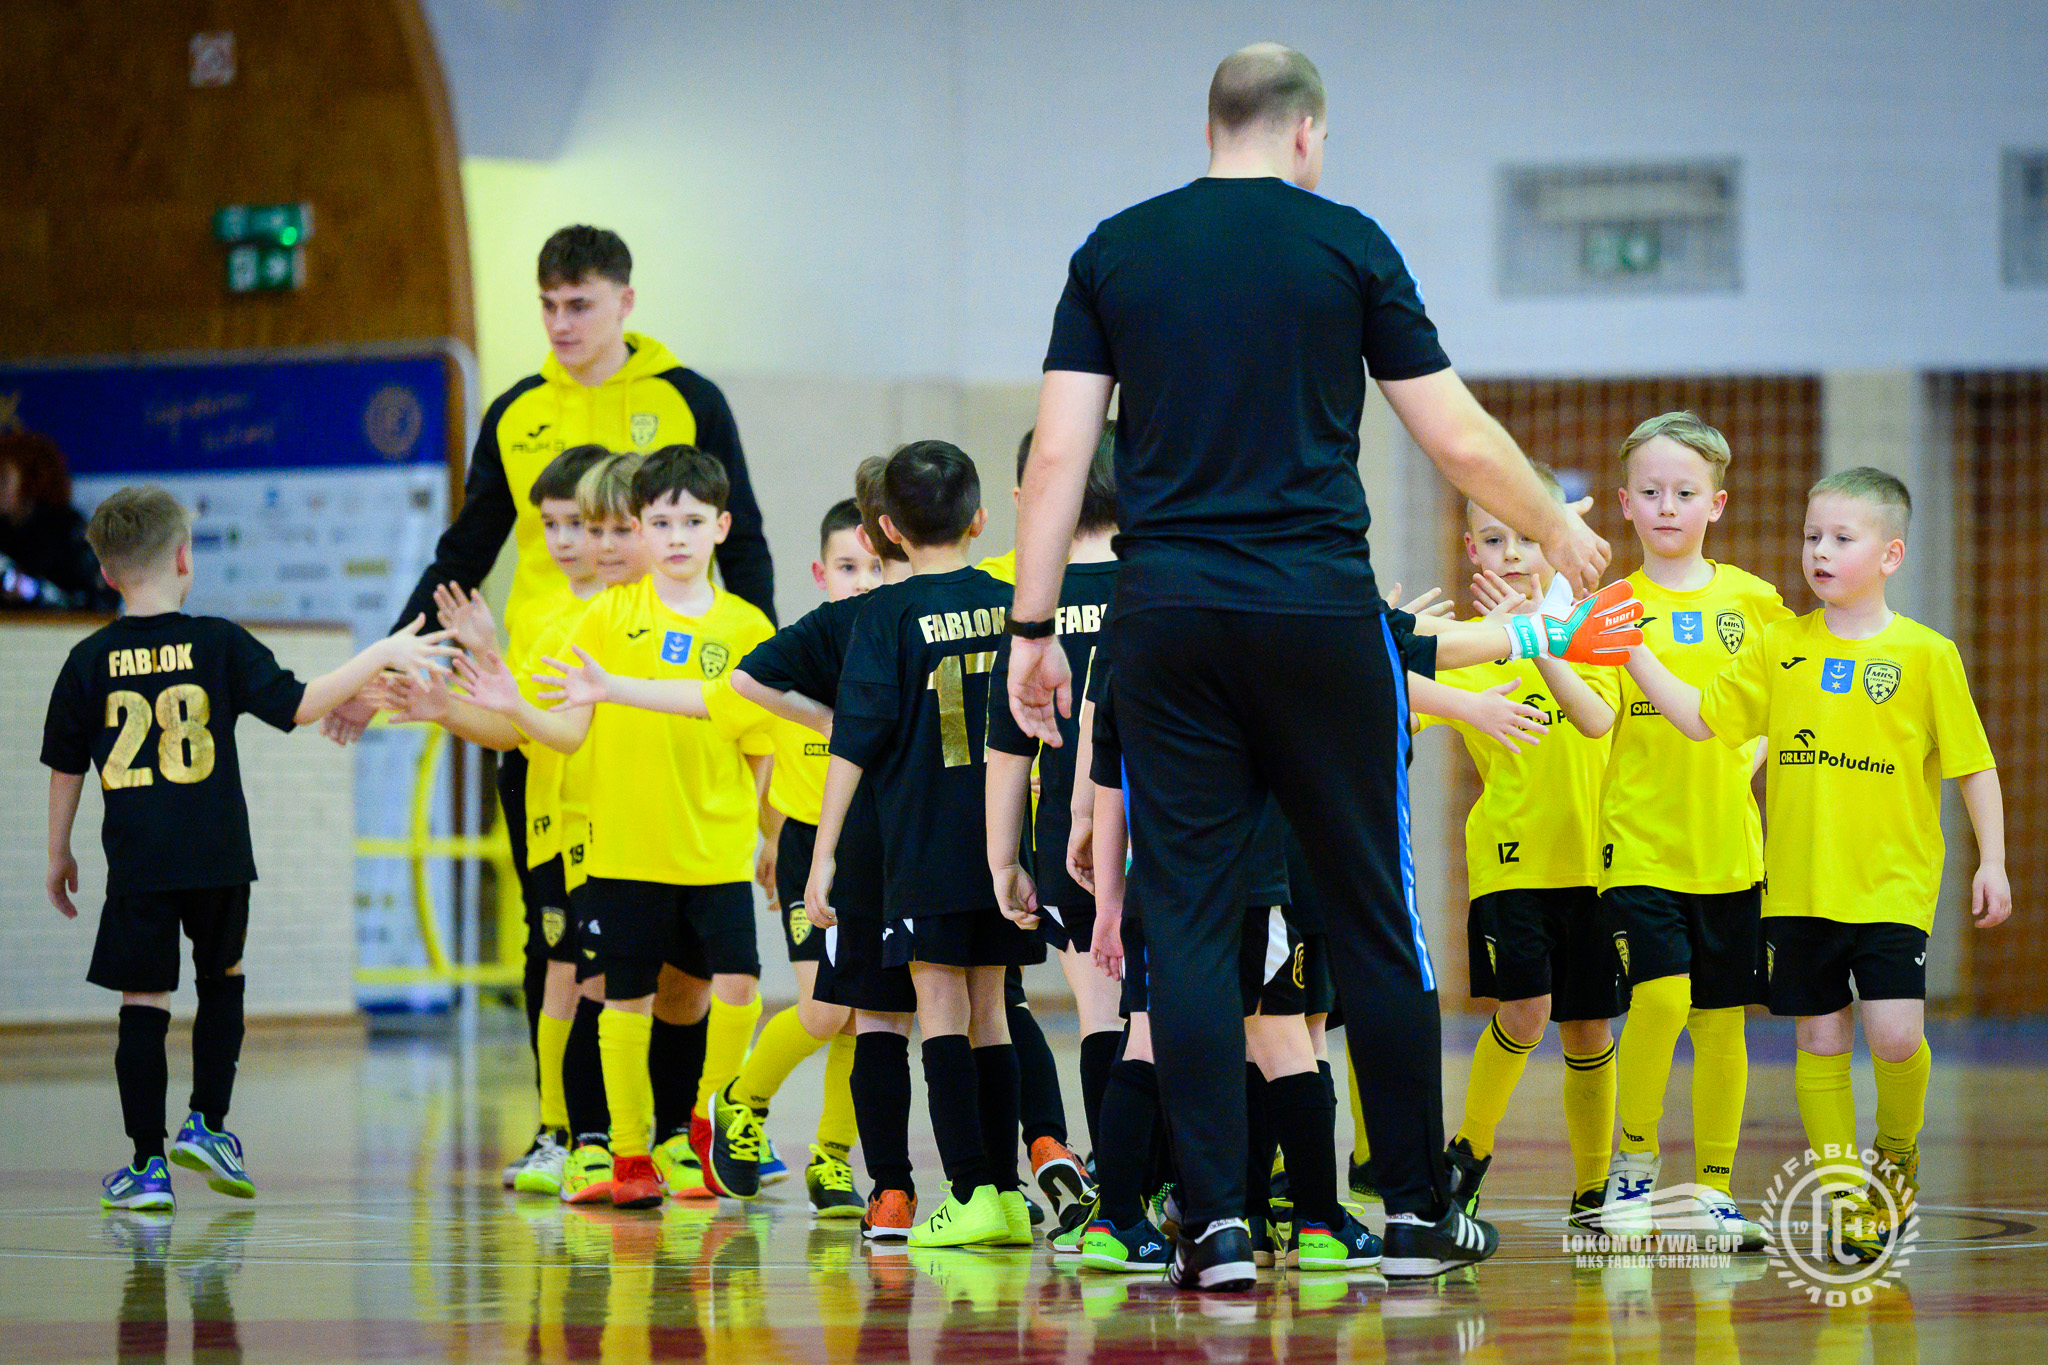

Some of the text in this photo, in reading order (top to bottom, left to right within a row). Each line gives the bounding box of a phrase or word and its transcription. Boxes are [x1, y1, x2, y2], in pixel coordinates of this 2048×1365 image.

[1055, 604, 1107, 635] FAB
[108, 642, 194, 678] FABLOK
[101, 683, 216, 791] 28
[1780, 750, 1895, 775] ORLEN Południe
